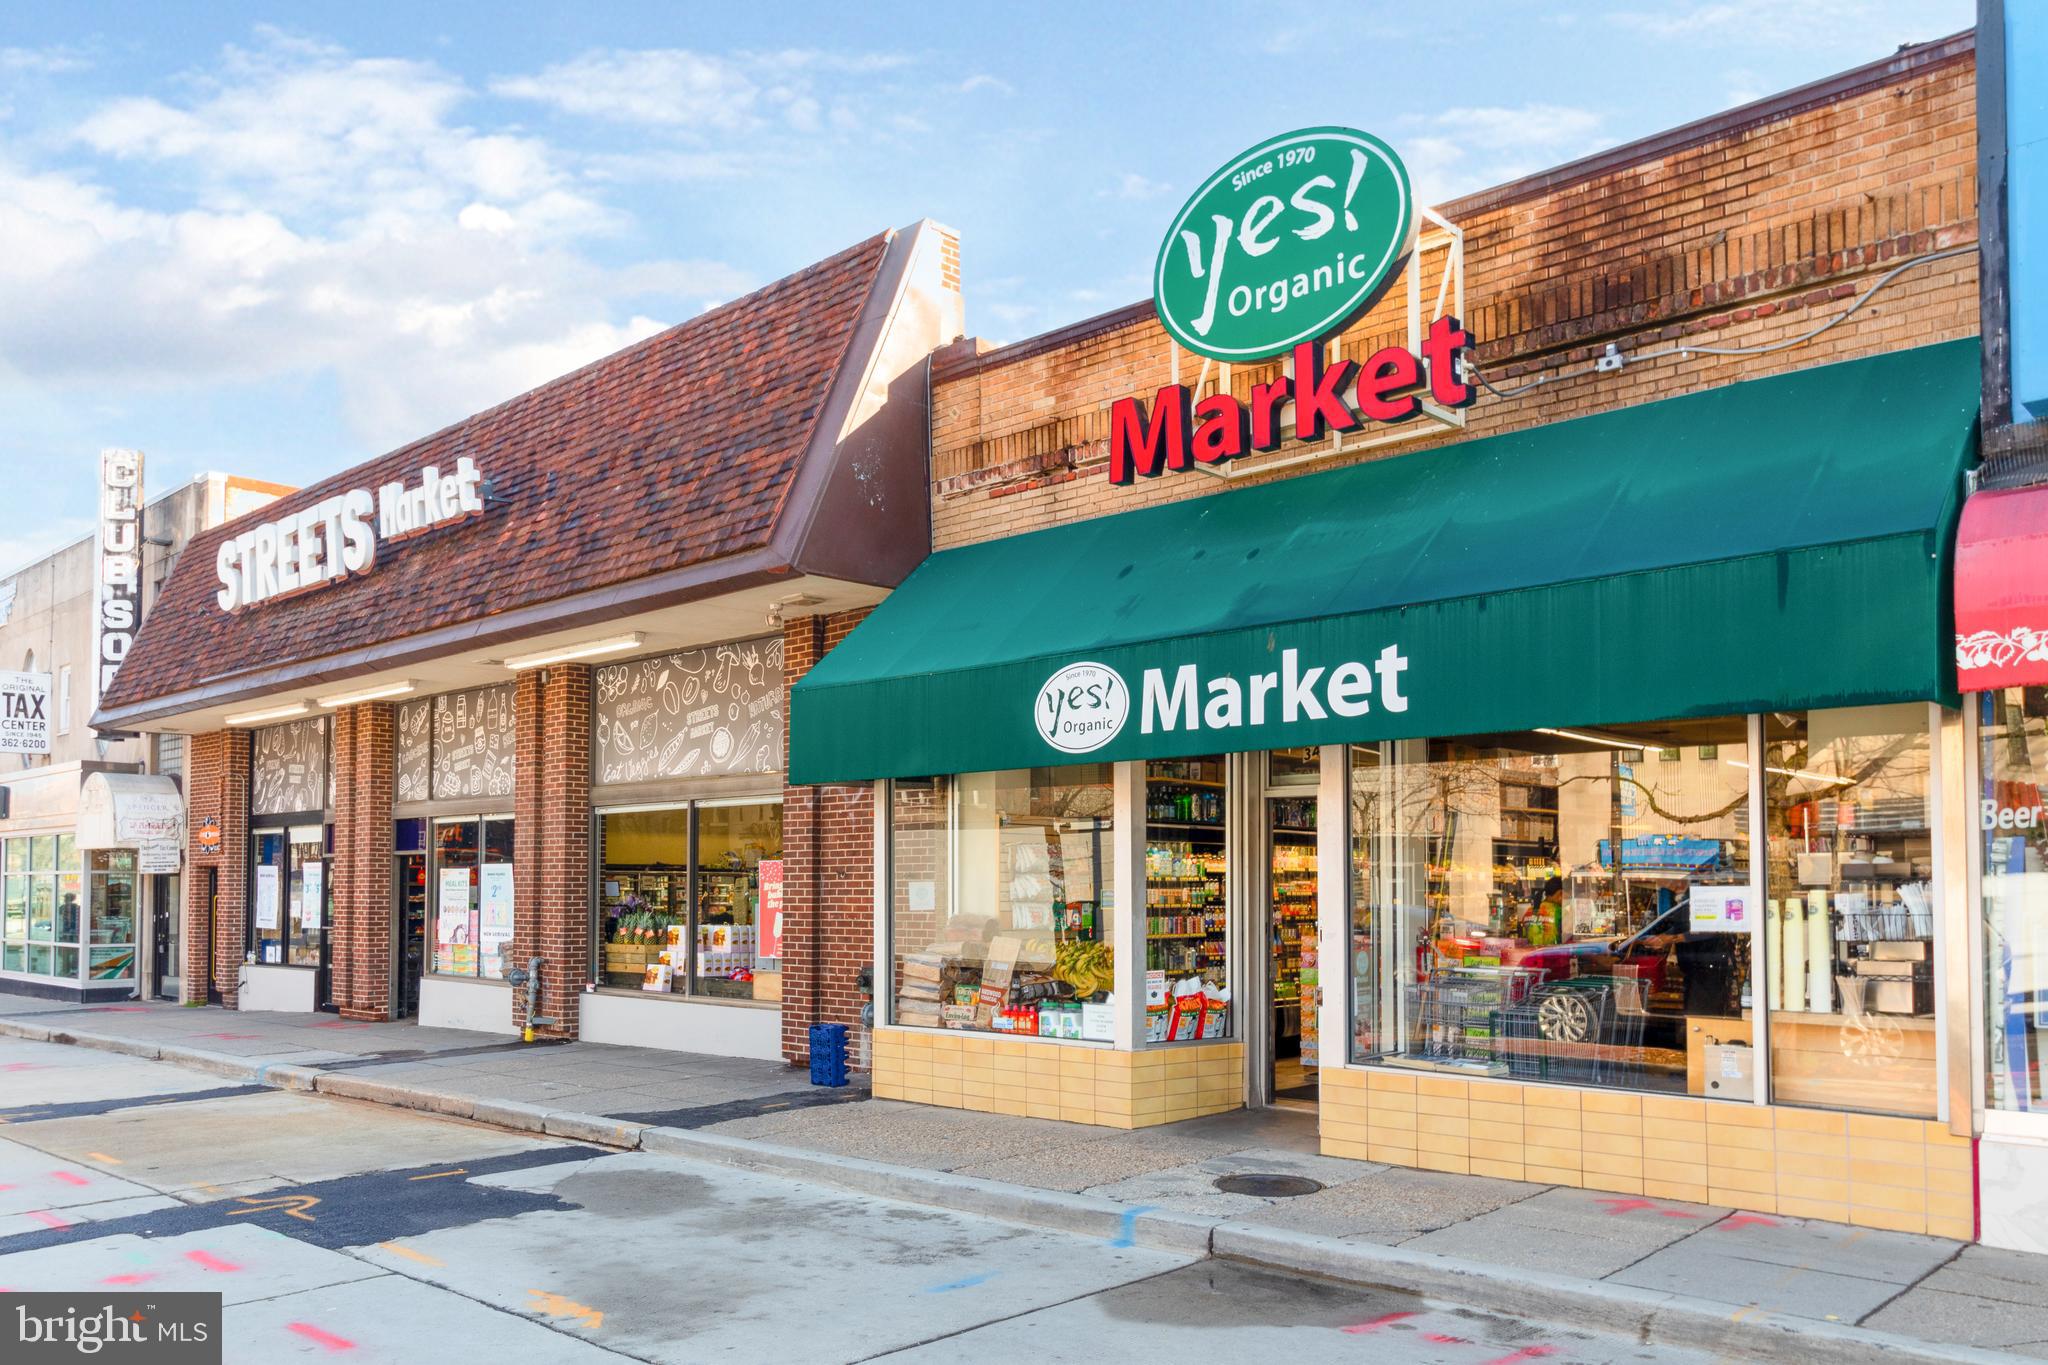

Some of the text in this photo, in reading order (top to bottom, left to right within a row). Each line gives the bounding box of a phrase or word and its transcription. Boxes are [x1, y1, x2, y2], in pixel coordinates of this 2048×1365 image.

[1231, 146, 1316, 192] Since 1970
[1228, 252, 1365, 317] Organic
[1109, 315, 1475, 486] Market
[216, 456, 484, 612] STREETS Market
[15, 676, 33, 684] THE
[1065, 670, 1097, 681] Since 1970
[2, 683, 46, 693] ORIGINAL
[1140, 643, 1409, 734] Market
[2, 692, 46, 720] TAX
[616, 696, 653, 718] ORGANIC
[686, 704, 720, 726] STREETS
[2, 720, 46, 731] CENTER
[1063, 717, 1113, 735] Organic
[603, 761, 624, 783] Eat
[1981, 799, 2043, 830] Beer
